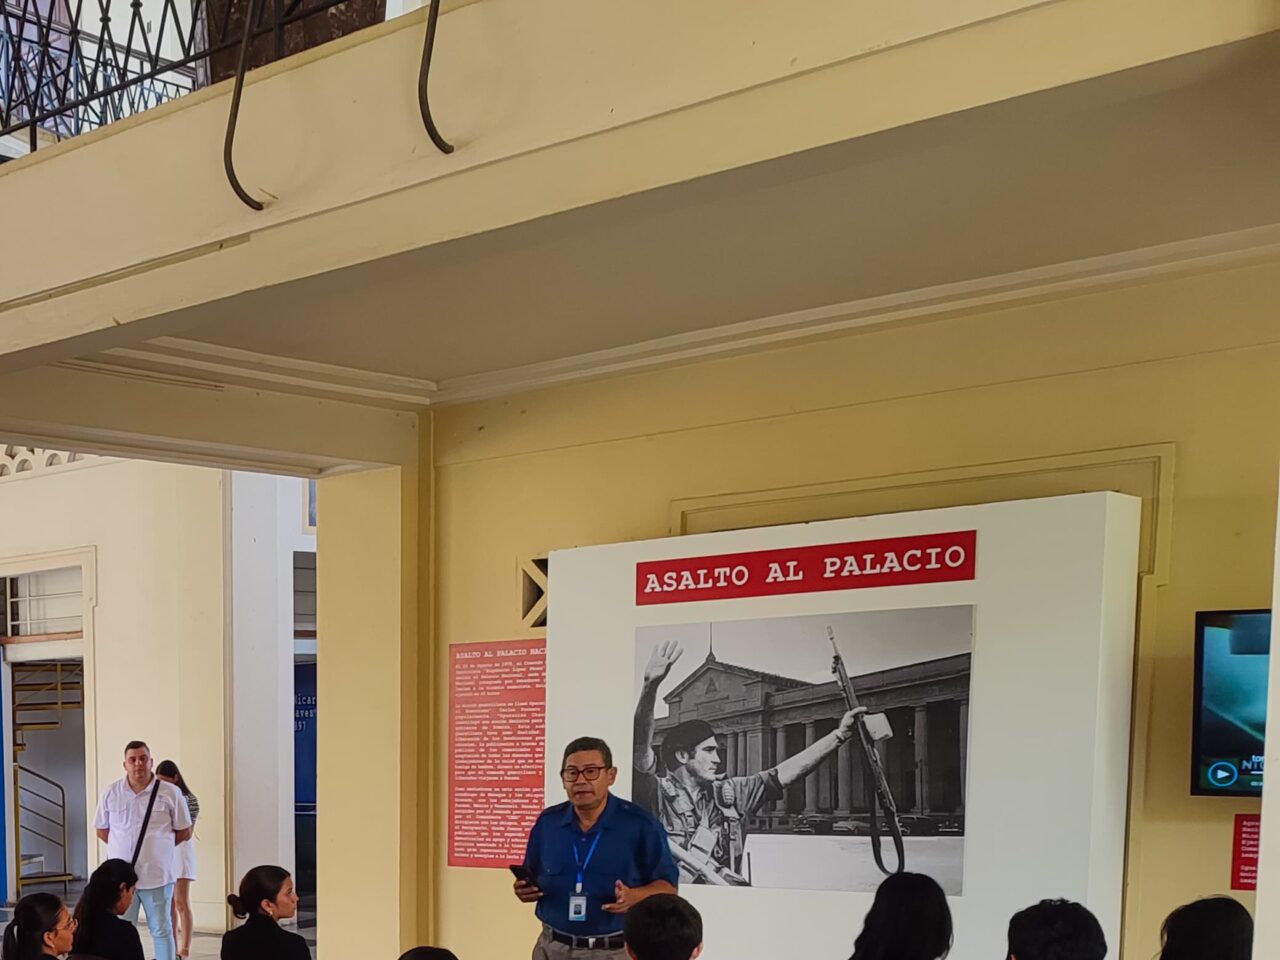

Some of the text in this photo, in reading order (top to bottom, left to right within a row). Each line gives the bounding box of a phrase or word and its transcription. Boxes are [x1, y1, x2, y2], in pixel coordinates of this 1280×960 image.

[643, 545, 966, 594] ASALTO AL PALACIO
[496, 648, 527, 657] PALACIO
